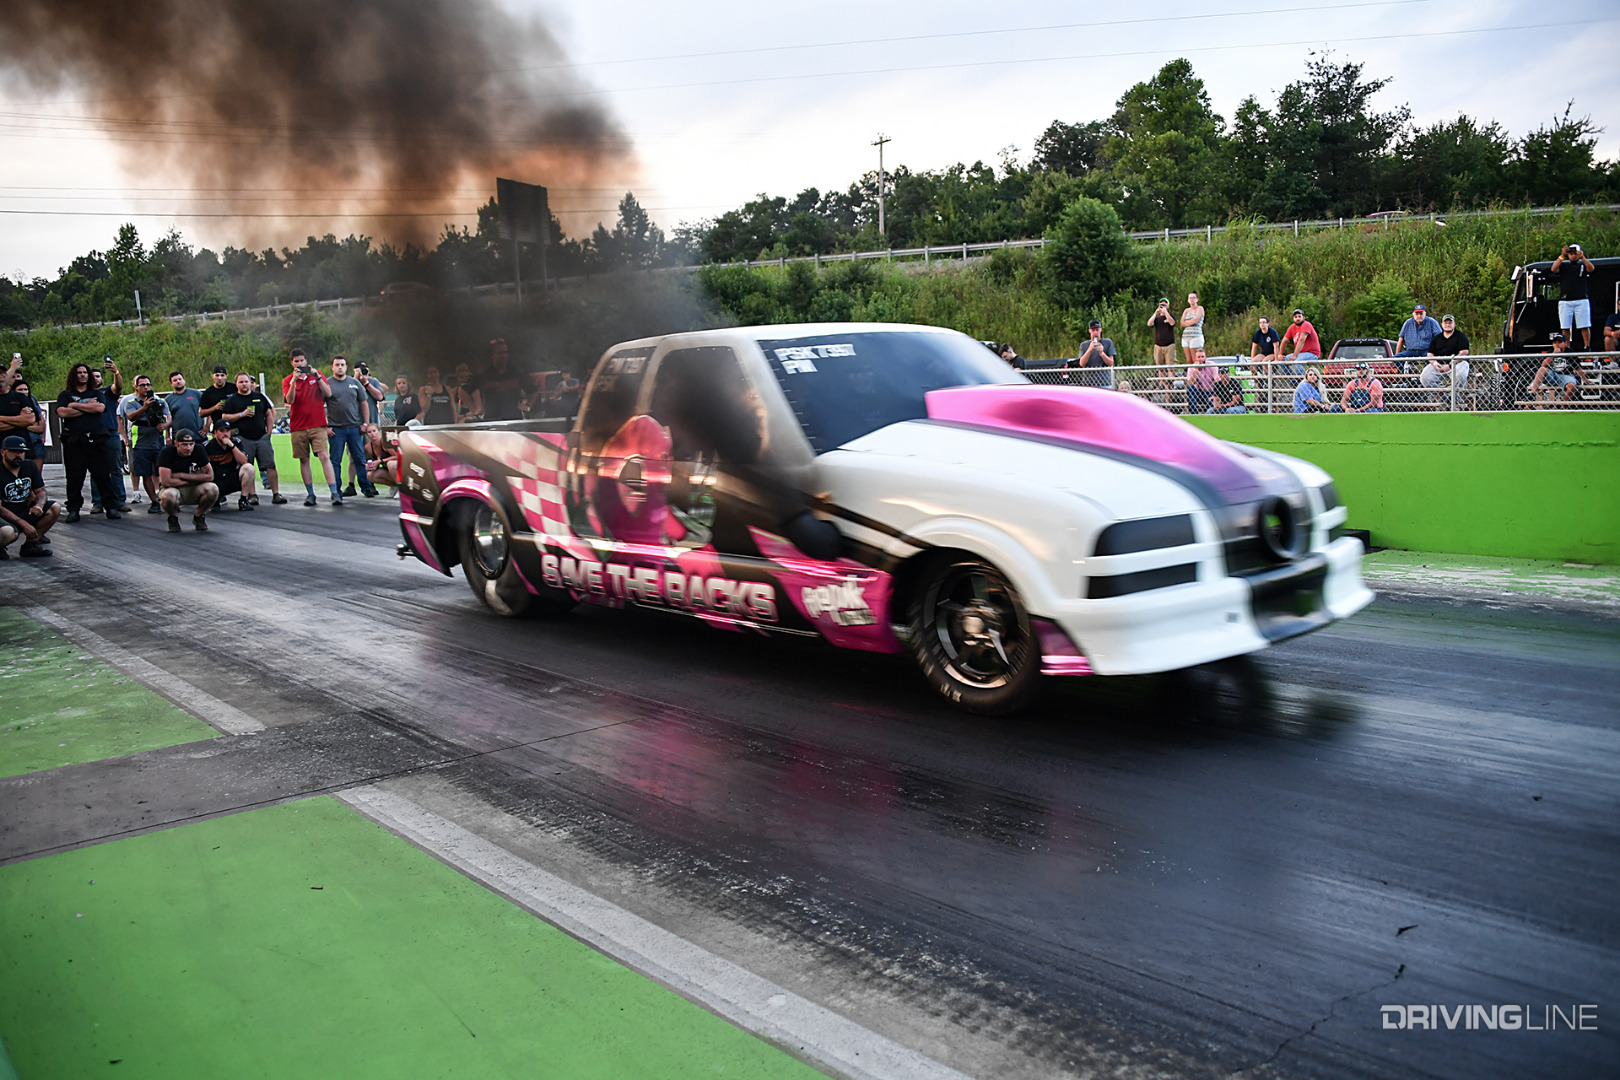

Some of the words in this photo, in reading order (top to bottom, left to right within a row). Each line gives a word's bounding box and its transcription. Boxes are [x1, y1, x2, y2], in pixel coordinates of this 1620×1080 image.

[541, 554, 605, 596] SAVE
[605, 562, 662, 605] THE
[663, 570, 779, 623] RACKS
